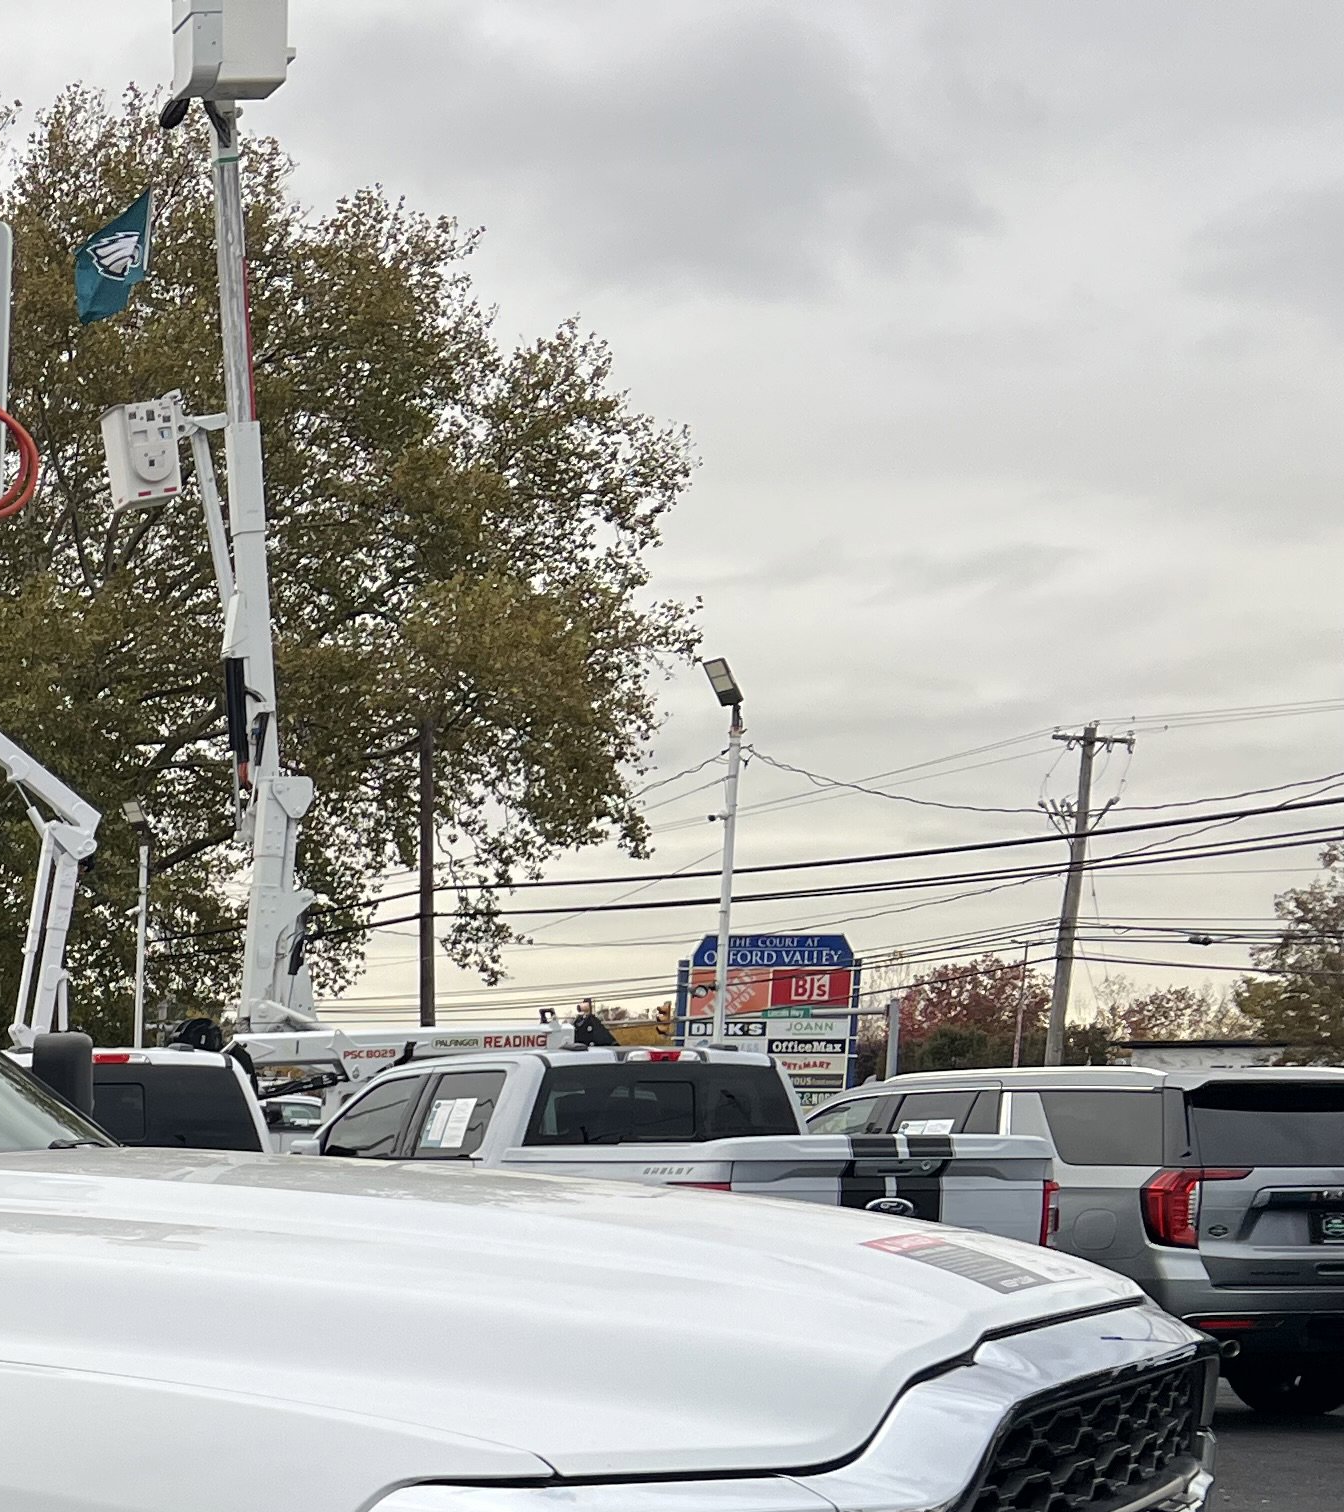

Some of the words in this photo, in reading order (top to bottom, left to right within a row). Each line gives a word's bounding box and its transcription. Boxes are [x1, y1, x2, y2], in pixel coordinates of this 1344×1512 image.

[757, 937, 798, 947] COURT
[805, 936, 821, 947] AT
[704, 949, 777, 966] OFORD
[691, 1023, 763, 1035] DIK'S
[786, 1022, 834, 1031] JOANN
[483, 1035, 547, 1048] READING
[772, 1041, 842, 1053] OfficeMax
[343, 1050, 364, 1060] PSC
[366, 1049, 396, 1059] 8029
